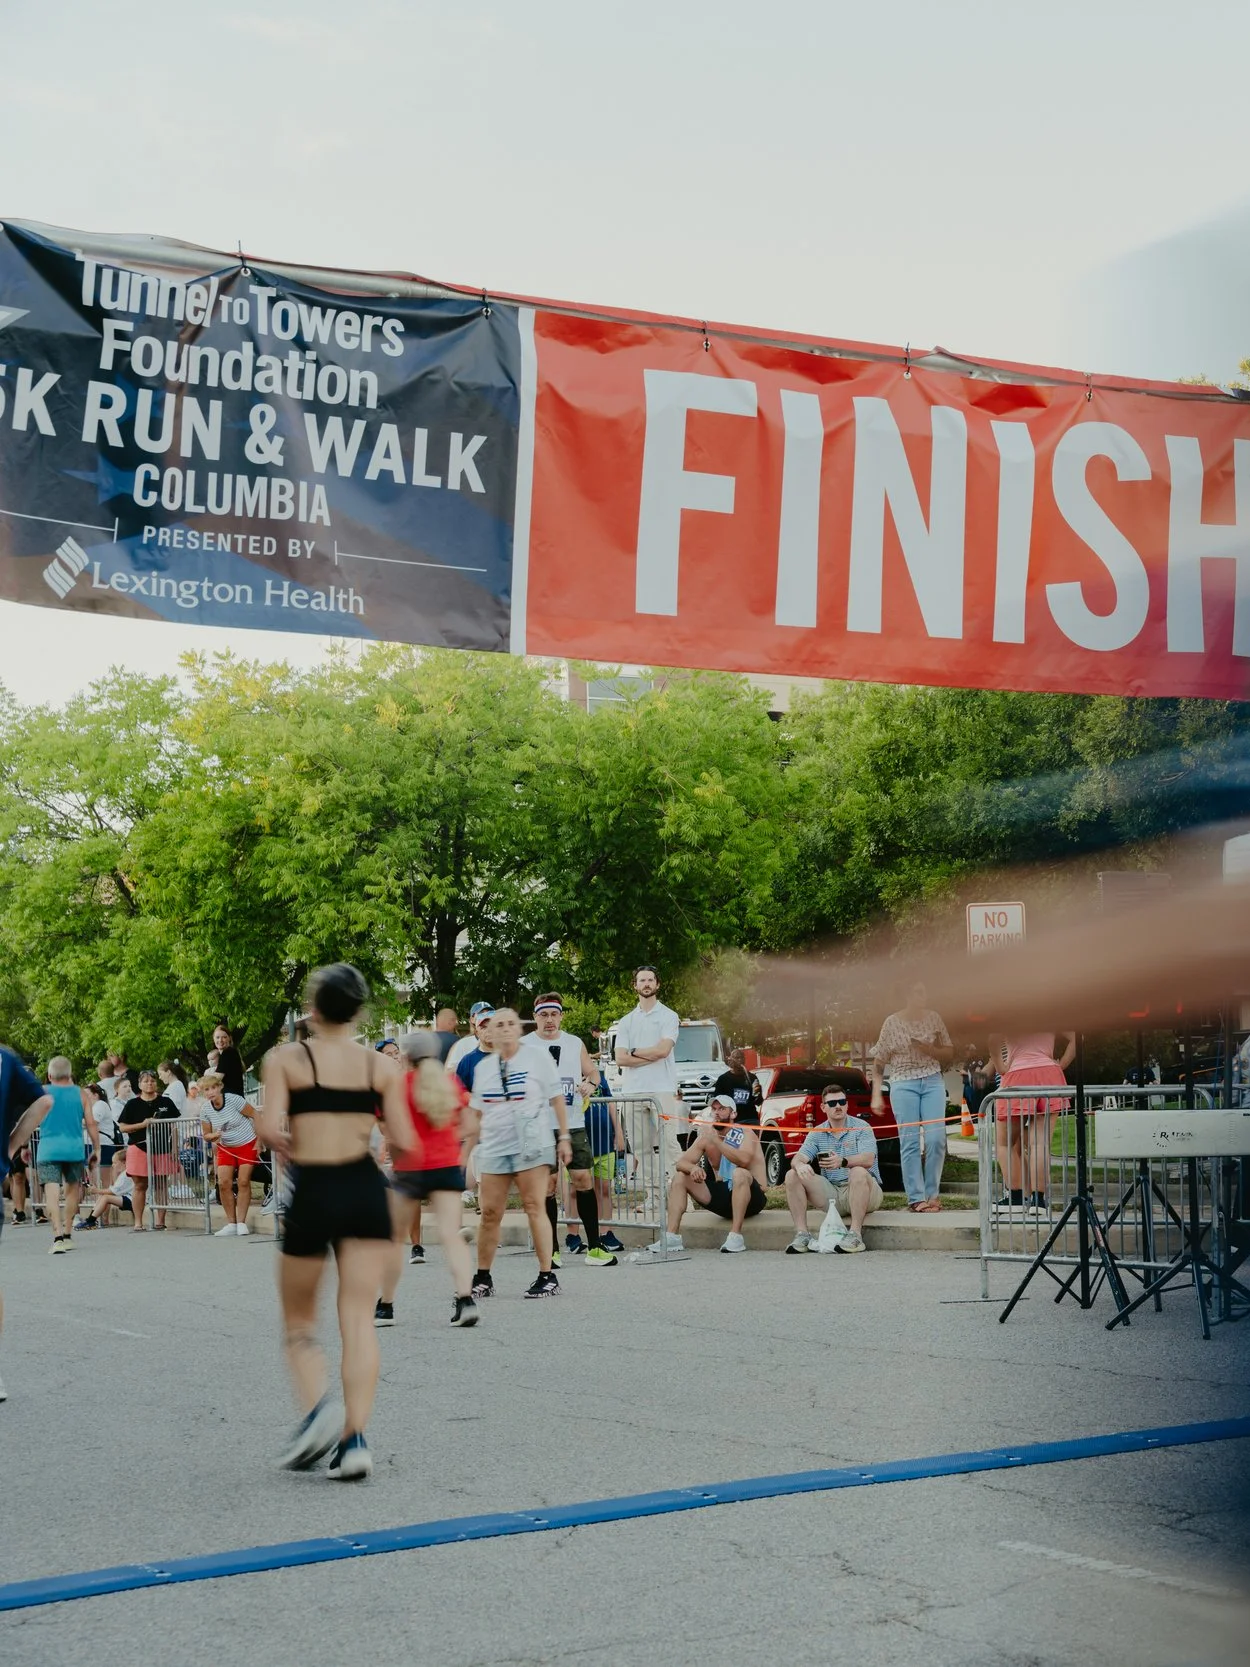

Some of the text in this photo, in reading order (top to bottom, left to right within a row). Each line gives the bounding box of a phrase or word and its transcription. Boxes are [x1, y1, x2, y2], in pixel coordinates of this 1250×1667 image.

[75, 250, 219, 327] Tunnel
[250, 284, 405, 358] Towers
[99, 318, 379, 410] Foundation
[0, 363, 488, 494] K RUN & WALK
[132, 463, 332, 527] COLUMBIA
[142, 525, 316, 560] PRESENTED BY
[91, 562, 366, 616] Lexington Health
[984, 911, 1008, 929] NO
